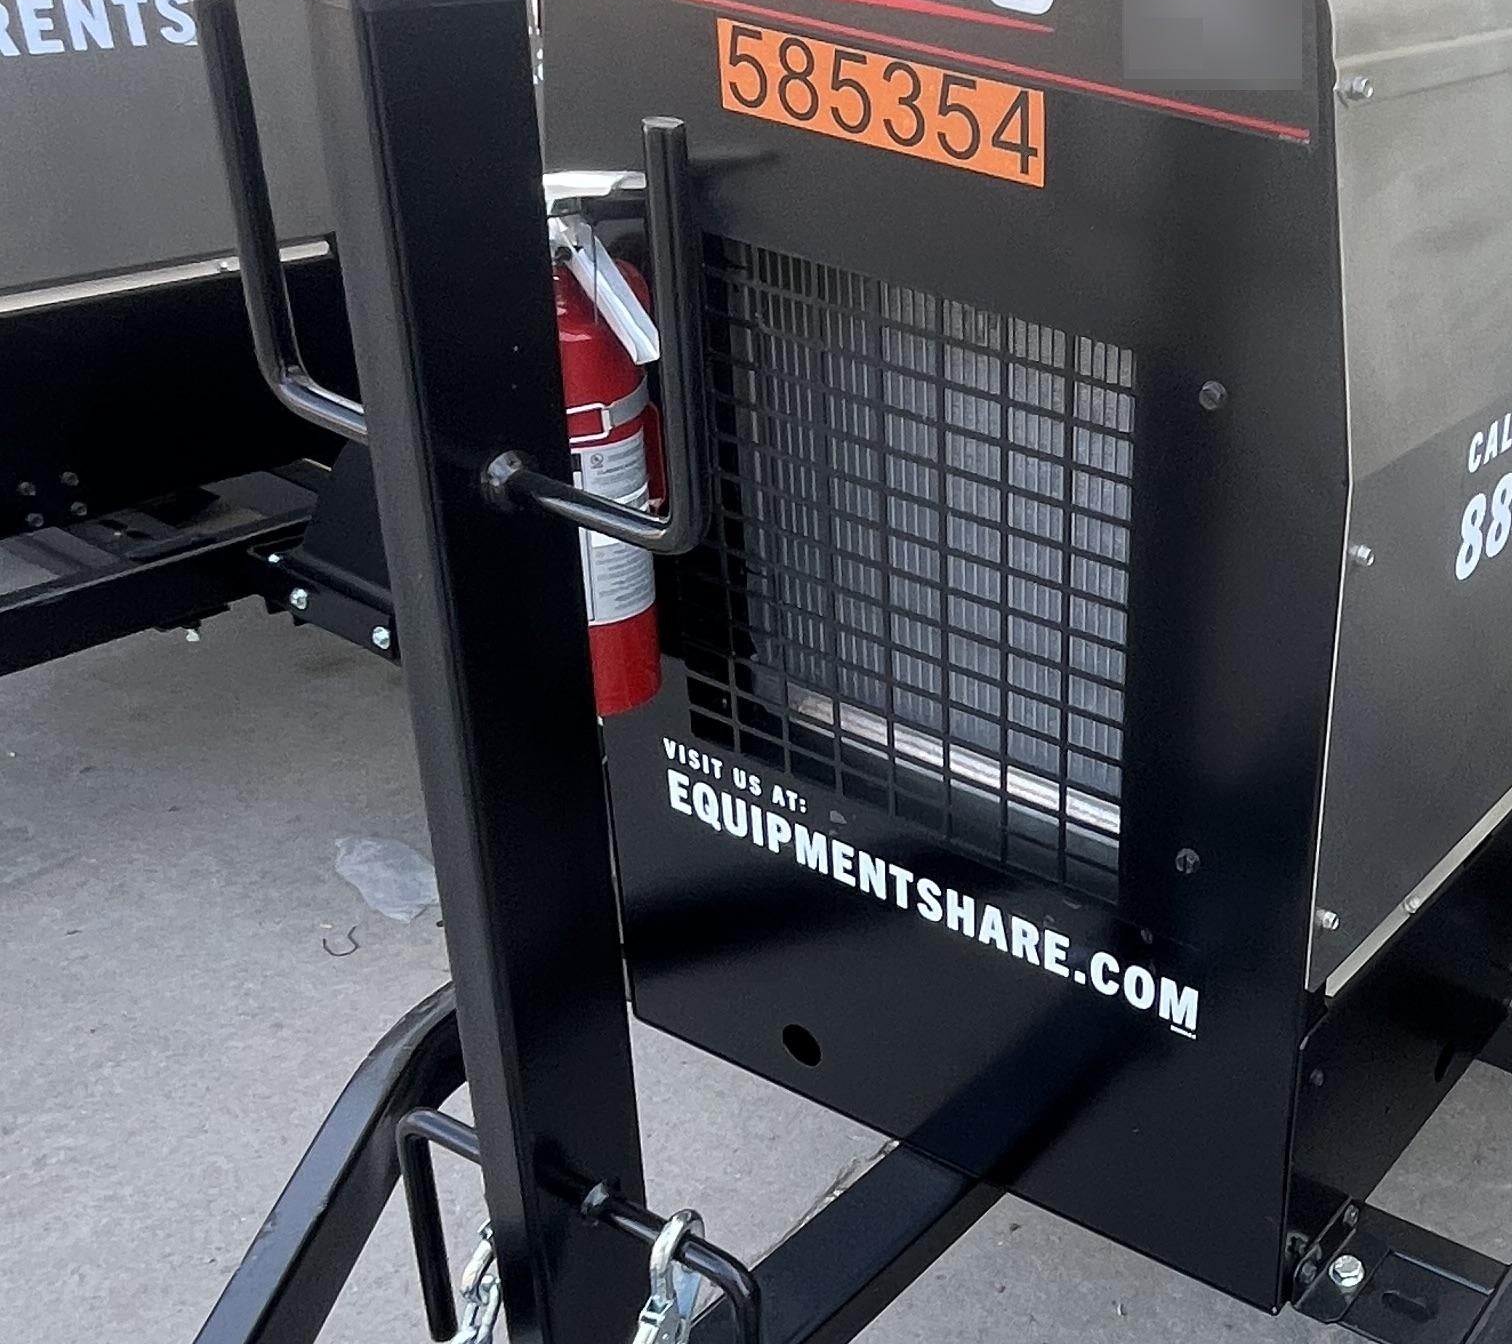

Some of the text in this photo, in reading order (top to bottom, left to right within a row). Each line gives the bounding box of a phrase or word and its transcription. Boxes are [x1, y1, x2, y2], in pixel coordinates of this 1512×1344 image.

[729, 25, 1039, 175] 585354
[663, 737, 807, 813] VISIT US AT:
[667, 768, 1199, 1031] EQUIPMENTSHARE.COM
